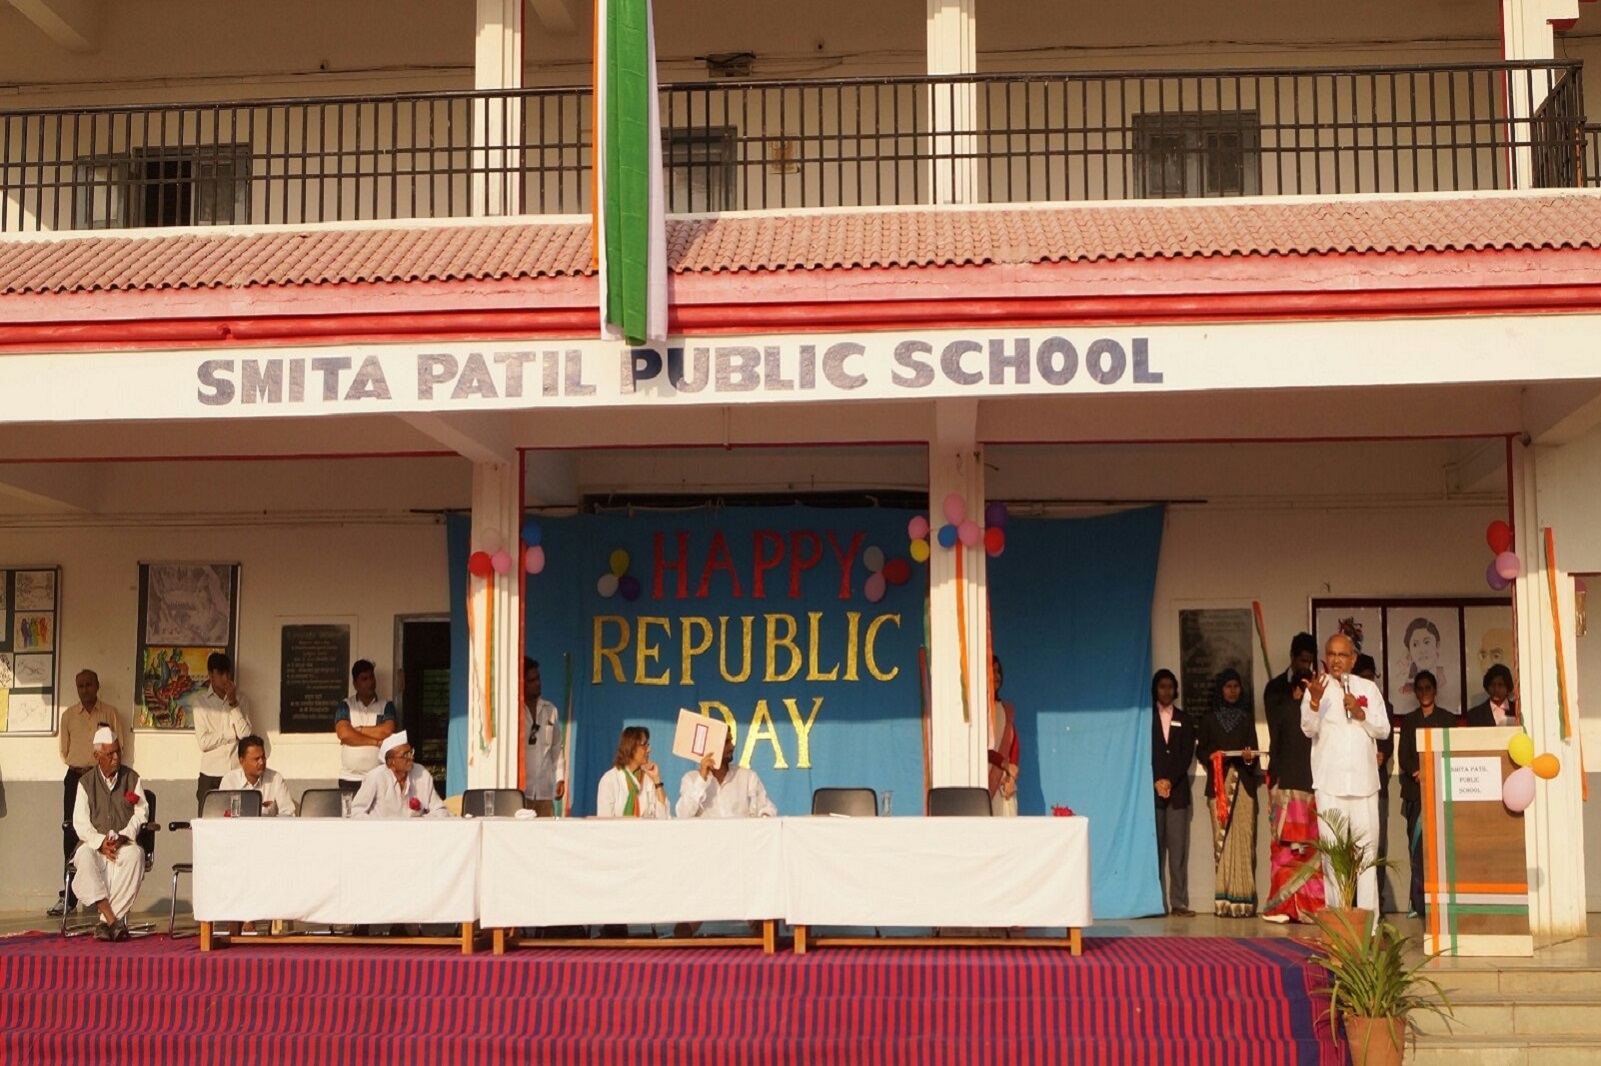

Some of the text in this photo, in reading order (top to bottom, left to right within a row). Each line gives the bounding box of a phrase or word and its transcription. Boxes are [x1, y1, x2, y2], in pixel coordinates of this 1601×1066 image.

[197, 336, 1163, 406] SMITA PATIL PUBLIC SCHOOL
[652, 529, 867, 599] HAPPY
[592, 611, 901, 686] REPUBLIC
